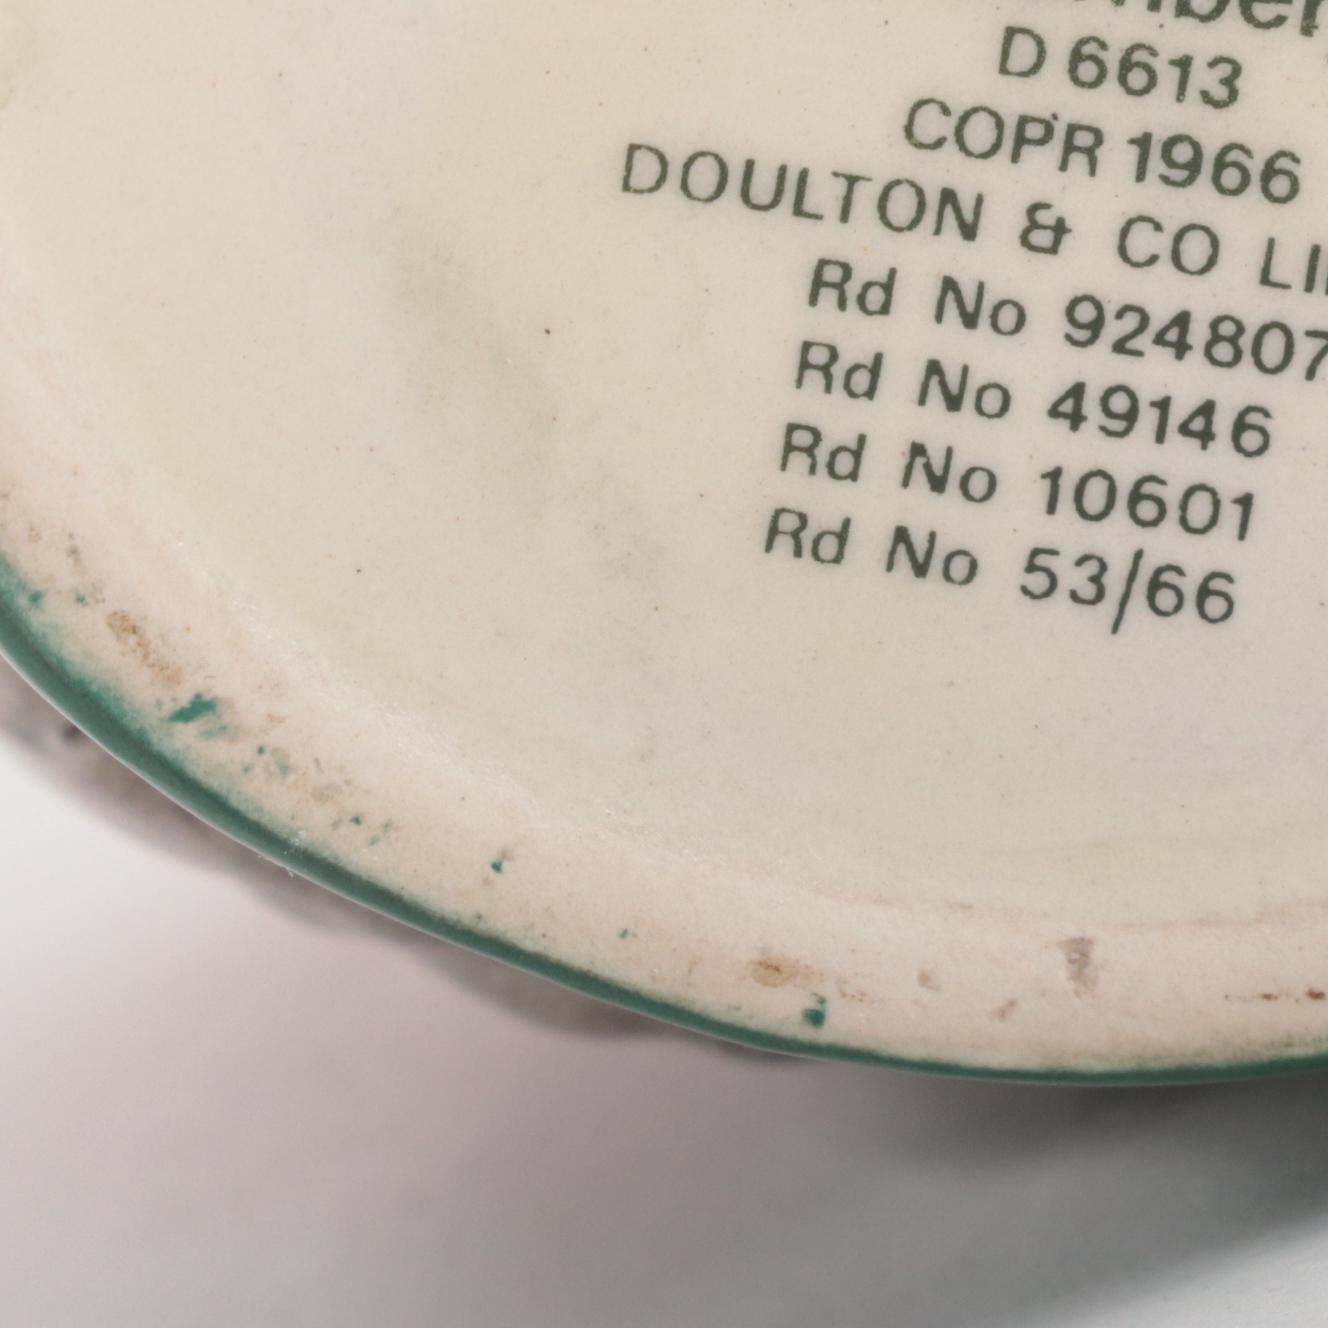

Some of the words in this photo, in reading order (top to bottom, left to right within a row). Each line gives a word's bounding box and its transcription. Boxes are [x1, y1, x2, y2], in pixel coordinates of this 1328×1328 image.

[998, 25, 1047, 79] D
[1067, 35, 1243, 110] 6613
[621, 142, 985, 242] DOULTON
[1018, 201, 1073, 256] &
[1116, 214, 1220, 277] CO
[903, 97, 1105, 178] COPR
[1127, 131, 1302, 205] 1966
[807, 257, 898, 317] Rd
[933, 274, 1027, 337] No
[794, 339, 884, 402] Rd
[917, 358, 1012, 420] No
[1047, 380, 1273, 459] 49146
[779, 421, 867, 483] Rd
[900, 440, 998, 504] No
[1039, 465, 1255, 542] 10601
[764, 506, 852, 566] Rd
[885, 524, 979, 587] No
[1019, 546, 1235, 636] 53/66
